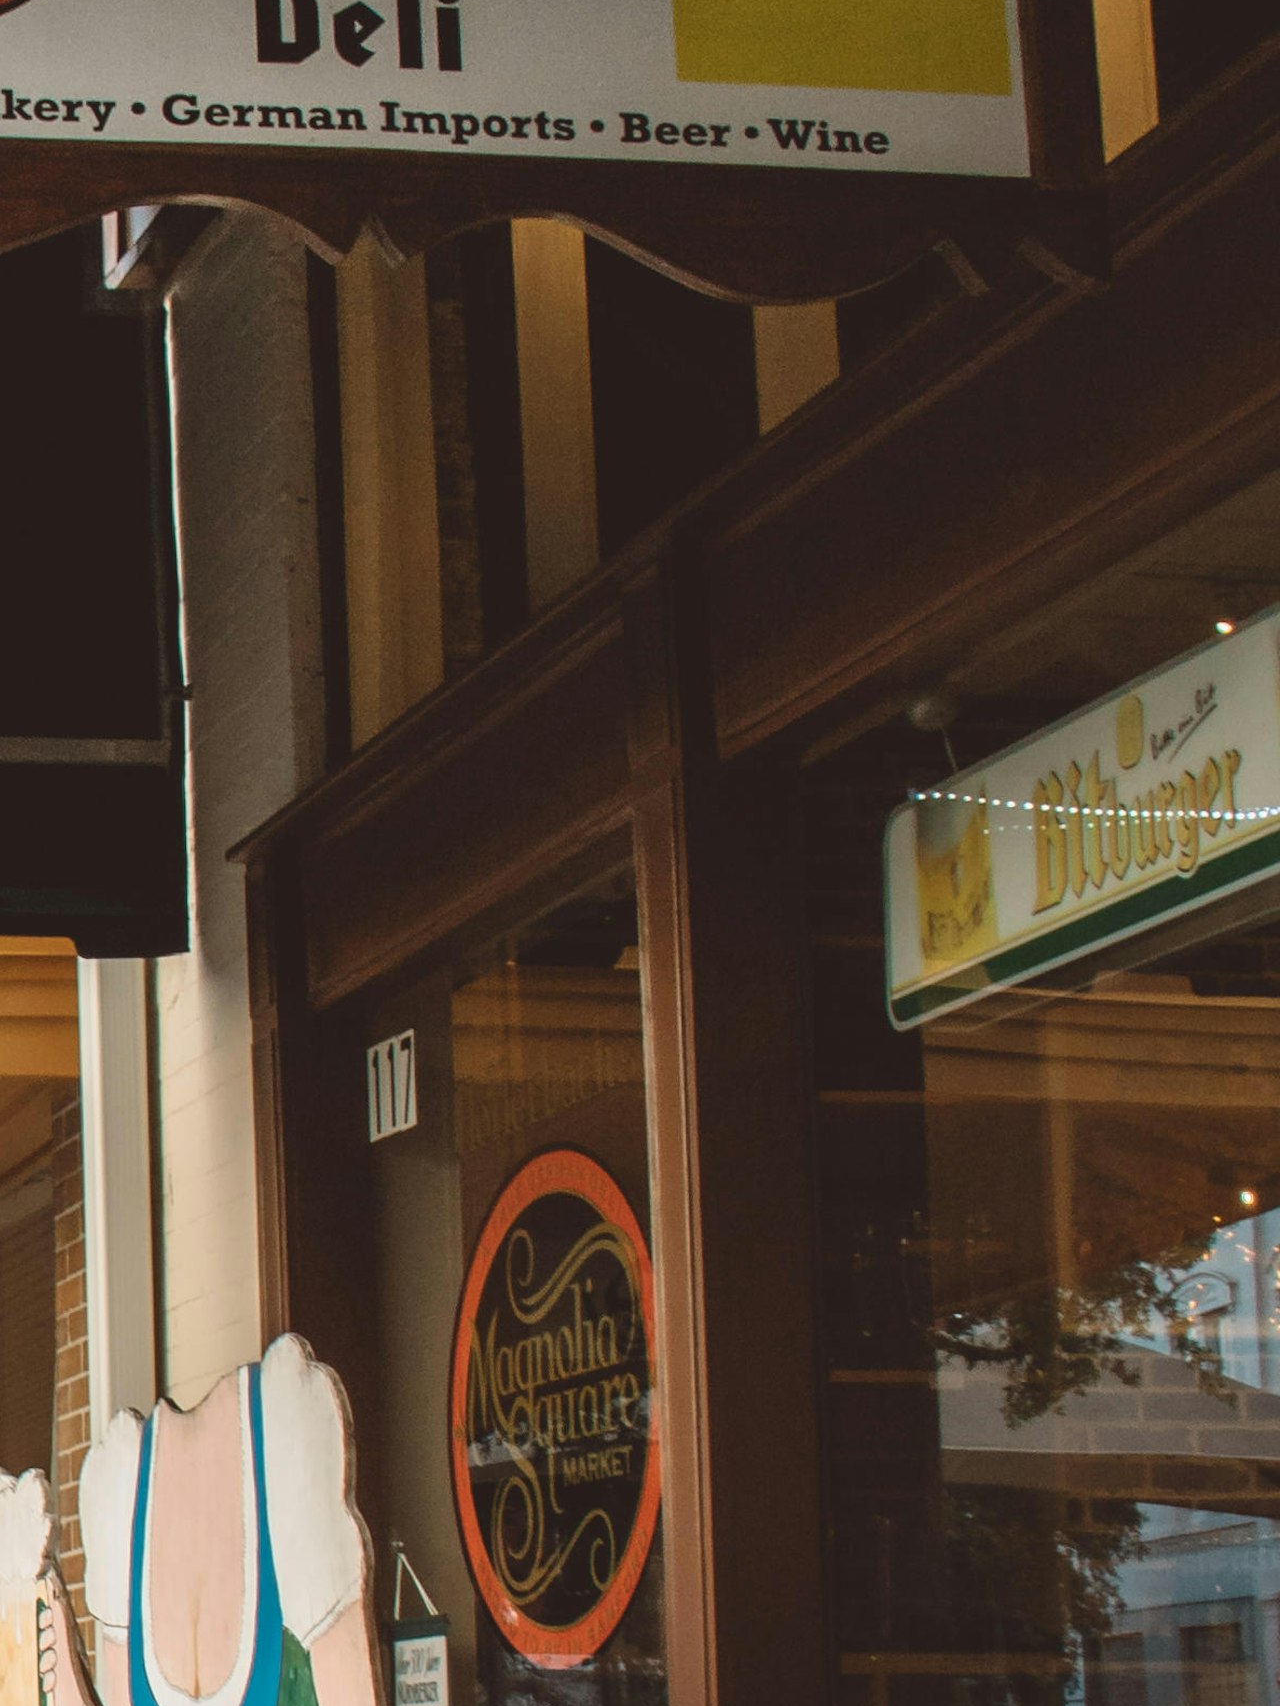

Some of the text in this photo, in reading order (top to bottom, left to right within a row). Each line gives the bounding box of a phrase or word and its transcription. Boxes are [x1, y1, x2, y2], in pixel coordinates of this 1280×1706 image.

[161, 94, 368, 131] German
[379, 101, 577, 145] Imports
[618, 111, 732, 148] Beer
[766, 118, 892, 155] Wine
[1031, 748, 1242, 917] Bitburger
[371, 1035, 412, 1135] 117
[468, 1277, 624, 1468] Magnolia
[562, 1444, 635, 1486] MARKET
